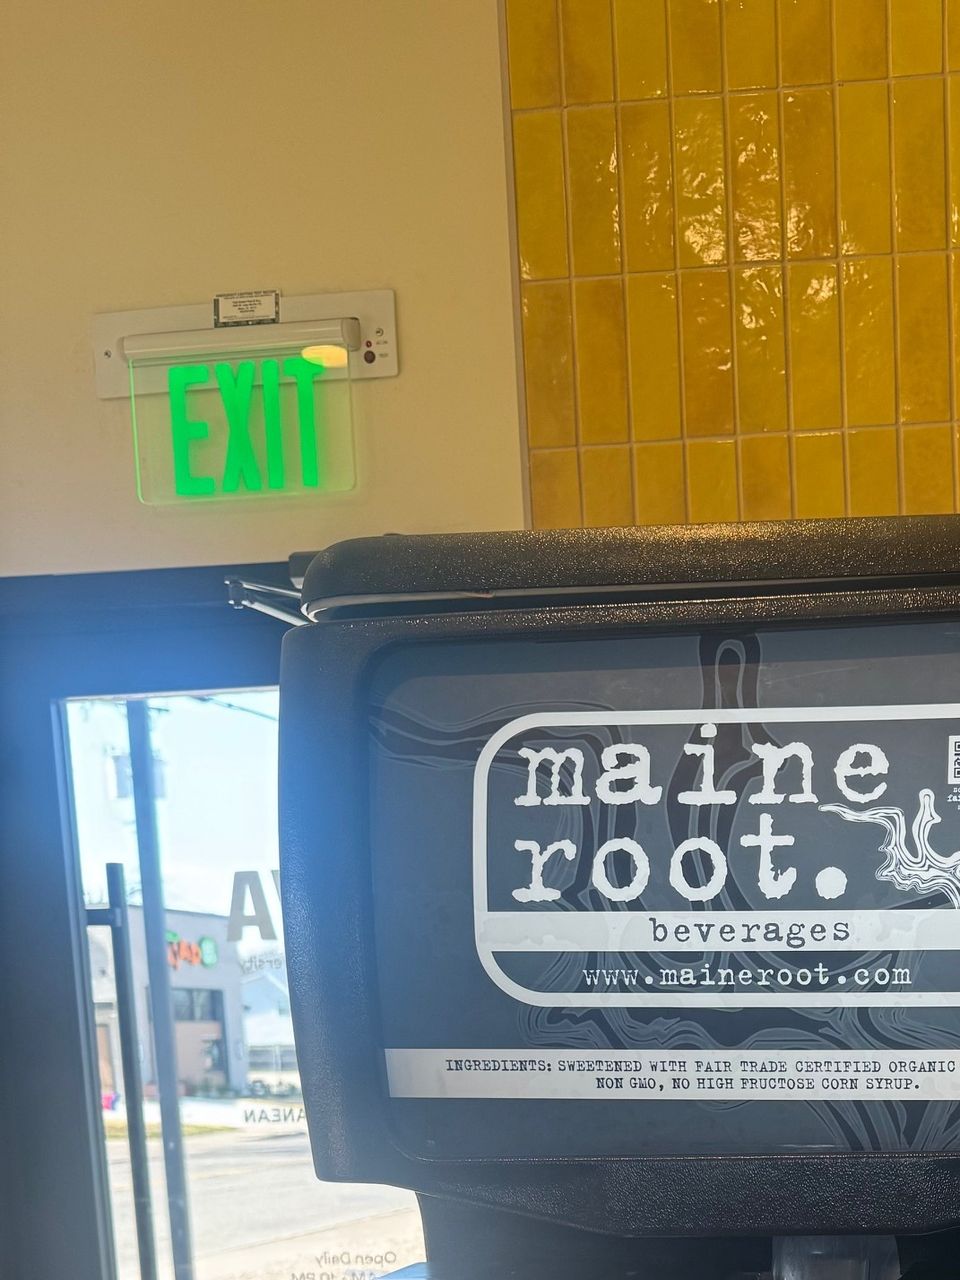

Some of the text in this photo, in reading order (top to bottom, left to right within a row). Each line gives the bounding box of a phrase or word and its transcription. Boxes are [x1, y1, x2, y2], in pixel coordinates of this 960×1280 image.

[168, 357, 325, 496] EXIT
[514, 722, 889, 806] maine
[512, 812, 848, 902] root.
[649, 917, 851, 949] beverages
[582, 963, 913, 986] www.maineroot.com
[446, 1059, 552, 1072] INGREDIENTS:
[558, 1060, 642, 1073] SWEETENED
[649, 1060, 687, 1073] WITH
[695, 1060, 732, 1073] FAIR
[740, 1060, 787, 1073] TRADE
[795, 1060, 882, 1073] CERTIFIED
[888, 1060, 956, 1073] ORGANIC
[596, 1077, 920, 1092] NON GMO, NO HIGH FRUCTOSE CORN SYRUP.
